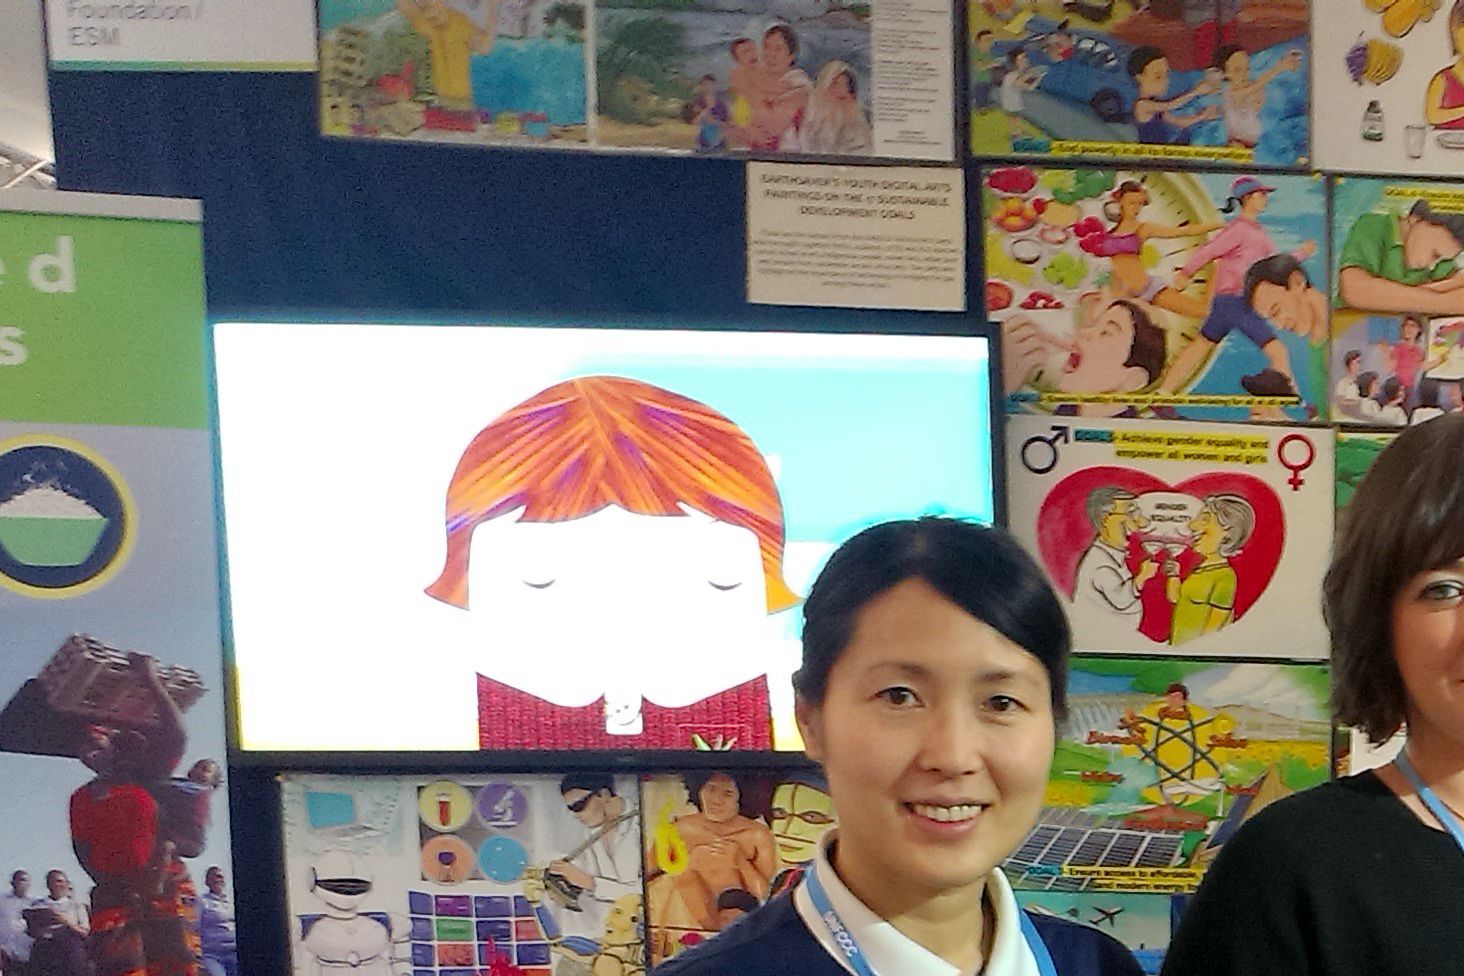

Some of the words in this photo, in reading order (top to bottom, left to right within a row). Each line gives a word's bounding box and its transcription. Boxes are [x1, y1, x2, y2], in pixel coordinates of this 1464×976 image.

[69, 26, 120, 46] ESM
[1166, 436, 1204, 446] gender
[1251, 440, 1269, 449] and
[1069, 868, 1101, 877] Ensure
[1104, 869, 1137, 878] access
[1138, 870, 1147, 878] to
